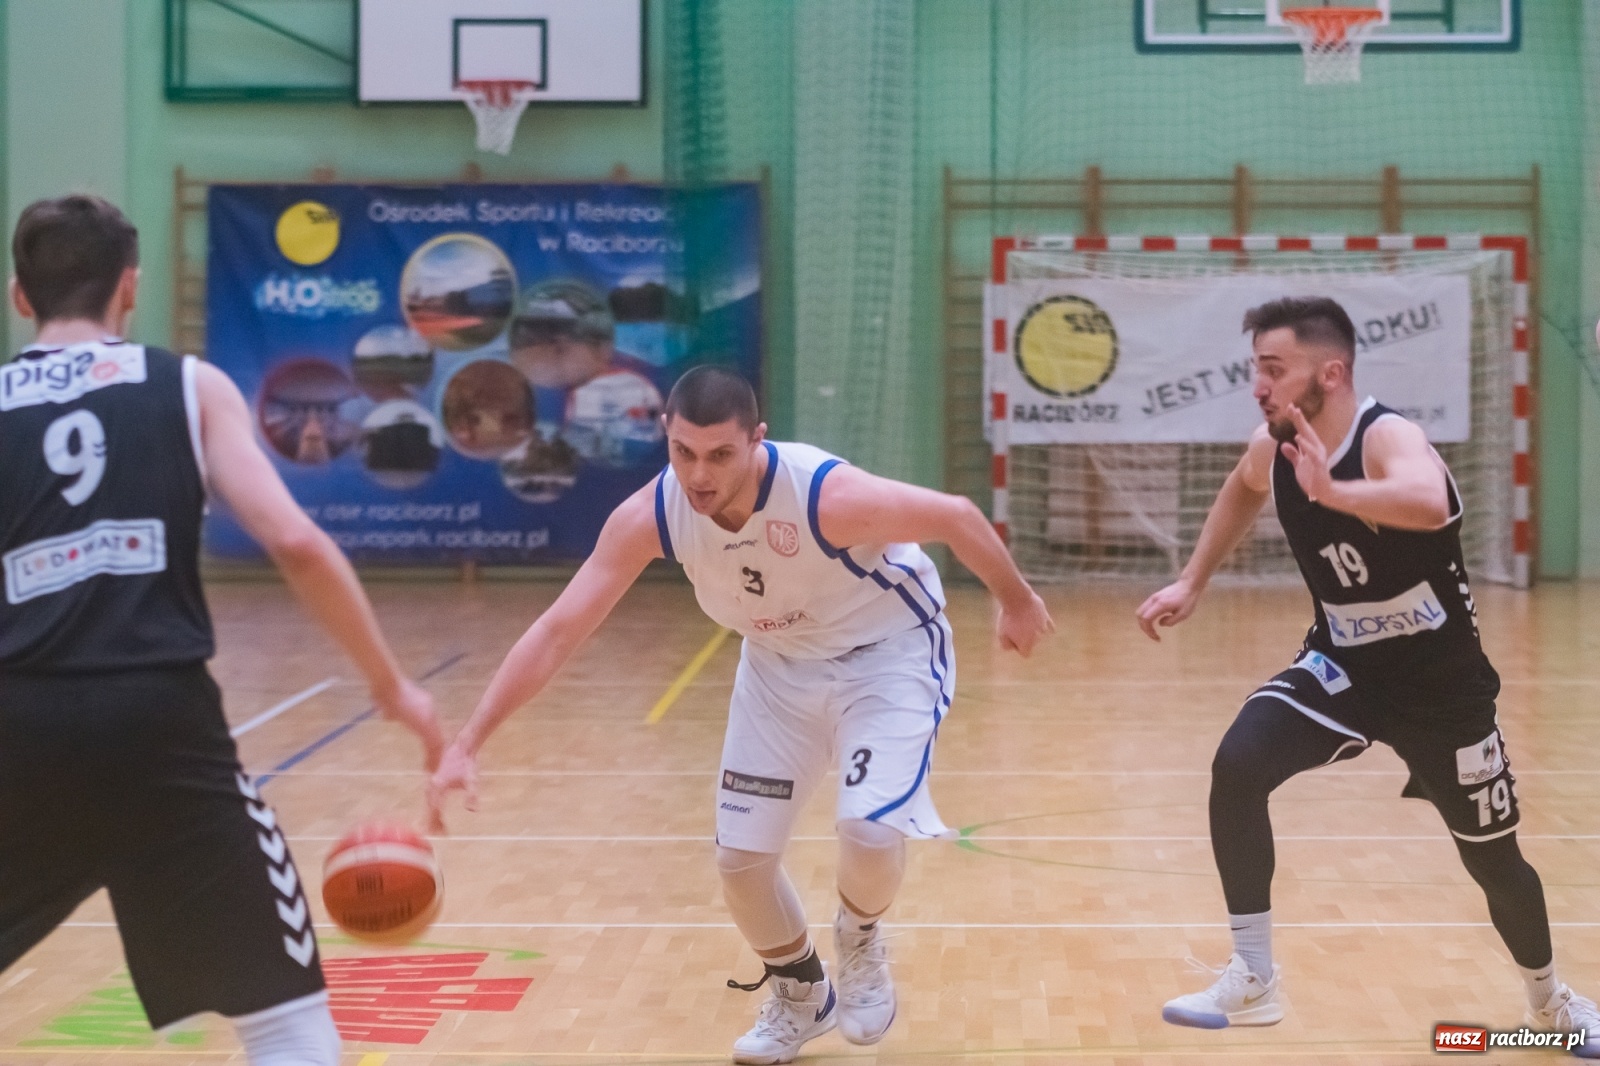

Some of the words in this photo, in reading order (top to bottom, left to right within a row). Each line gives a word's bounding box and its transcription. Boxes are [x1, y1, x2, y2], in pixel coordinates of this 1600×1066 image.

[1142, 370, 1213, 415] JEST
[43, 408, 107, 506] 9
[742, 566, 765, 597] 3
[1318, 542, 1369, 588] 19
[1345, 600, 1441, 639] ZOFSTAL
[845, 748, 872, 787] 3
[1467, 778, 1512, 828] 19
